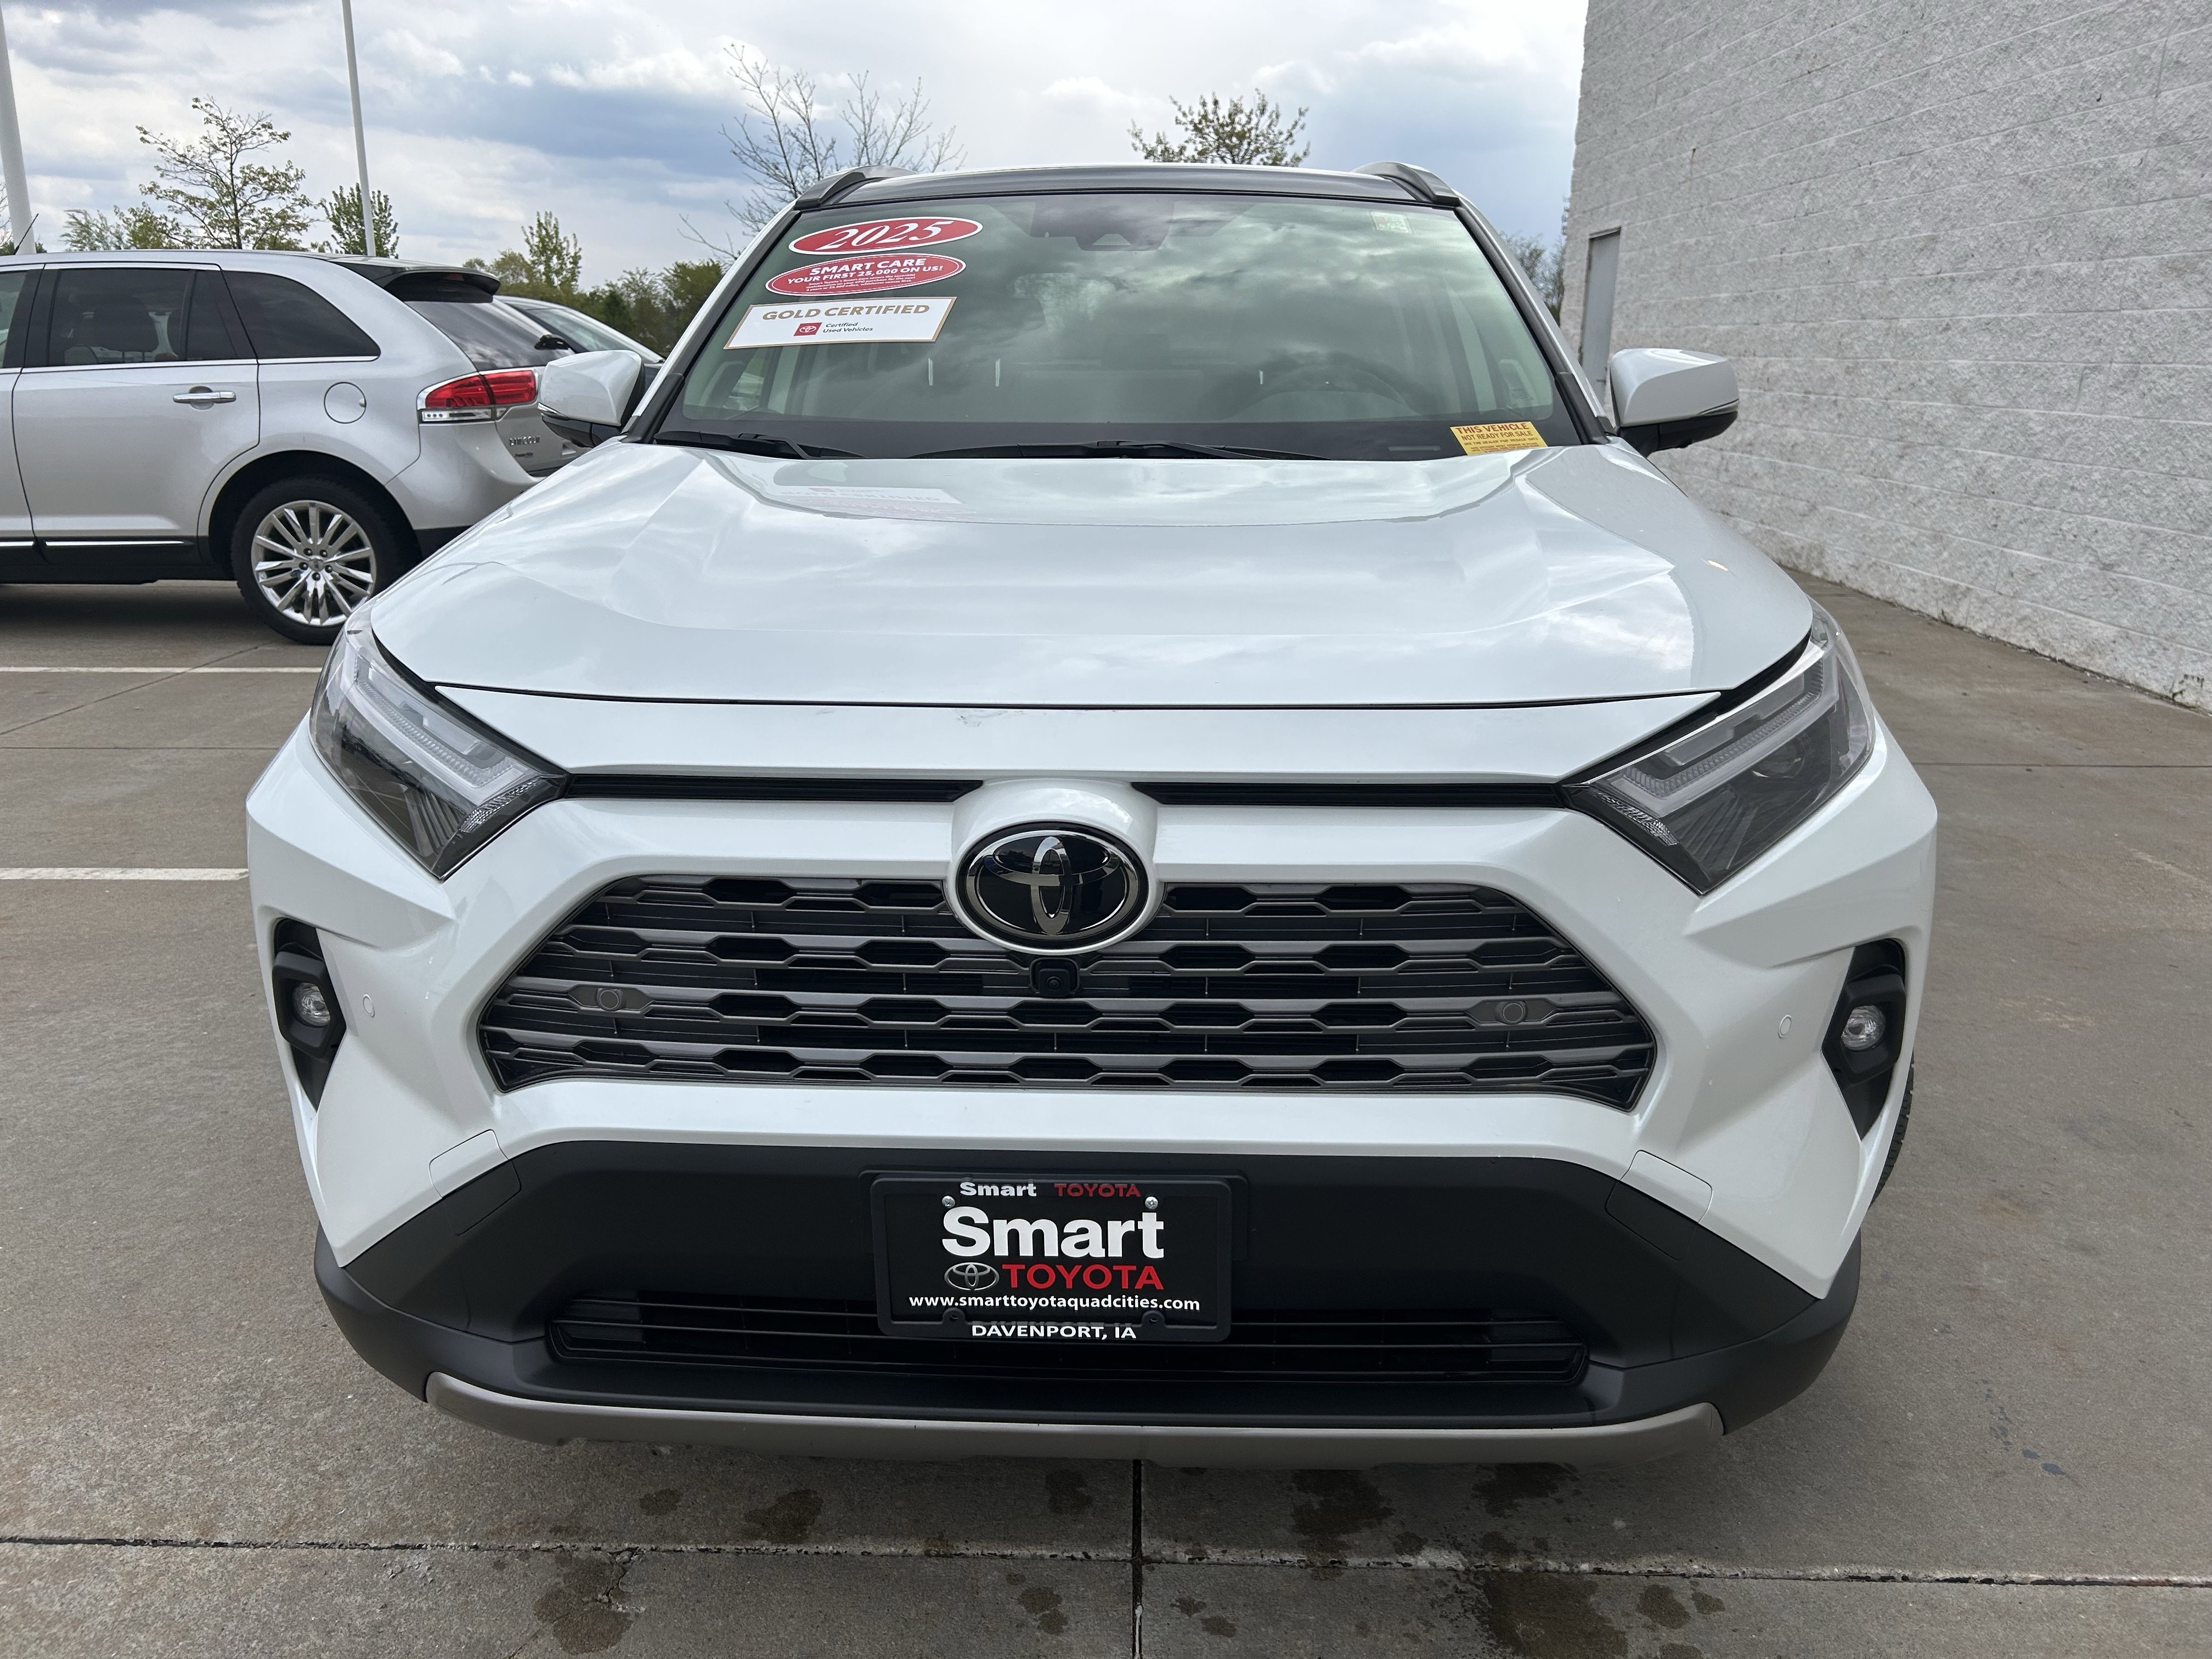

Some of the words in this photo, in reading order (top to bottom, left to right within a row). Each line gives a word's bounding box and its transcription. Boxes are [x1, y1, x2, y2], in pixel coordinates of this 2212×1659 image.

[815, 221, 955, 251] 2025
[809, 262, 875, 275] SMART
[877, 258, 927, 269] CARE
[788, 276, 821, 284] YOUR
[822, 272, 857, 280] FIRST
[857, 269, 898, 277] 25,000
[762, 308, 821, 320] GOLD
[824, 304, 931, 317] CERTIFIED
[1455, 426, 1482, 435] THIS
[1482, 423, 1530, 433] VEHICLE
[960, 1182, 1037, 1197] Smart
[1054, 1183, 1141, 1198] TOYOTA
[942, 1206, 1165, 1259] Smart
[1002, 1263, 1165, 1290] TOYOTA
[909, 1294, 1200, 1312] www.smarttoyotaquadcities.com
[972, 1325, 1108, 1340] DAVENPORT,
[1115, 1327, 1136, 1339] IA
